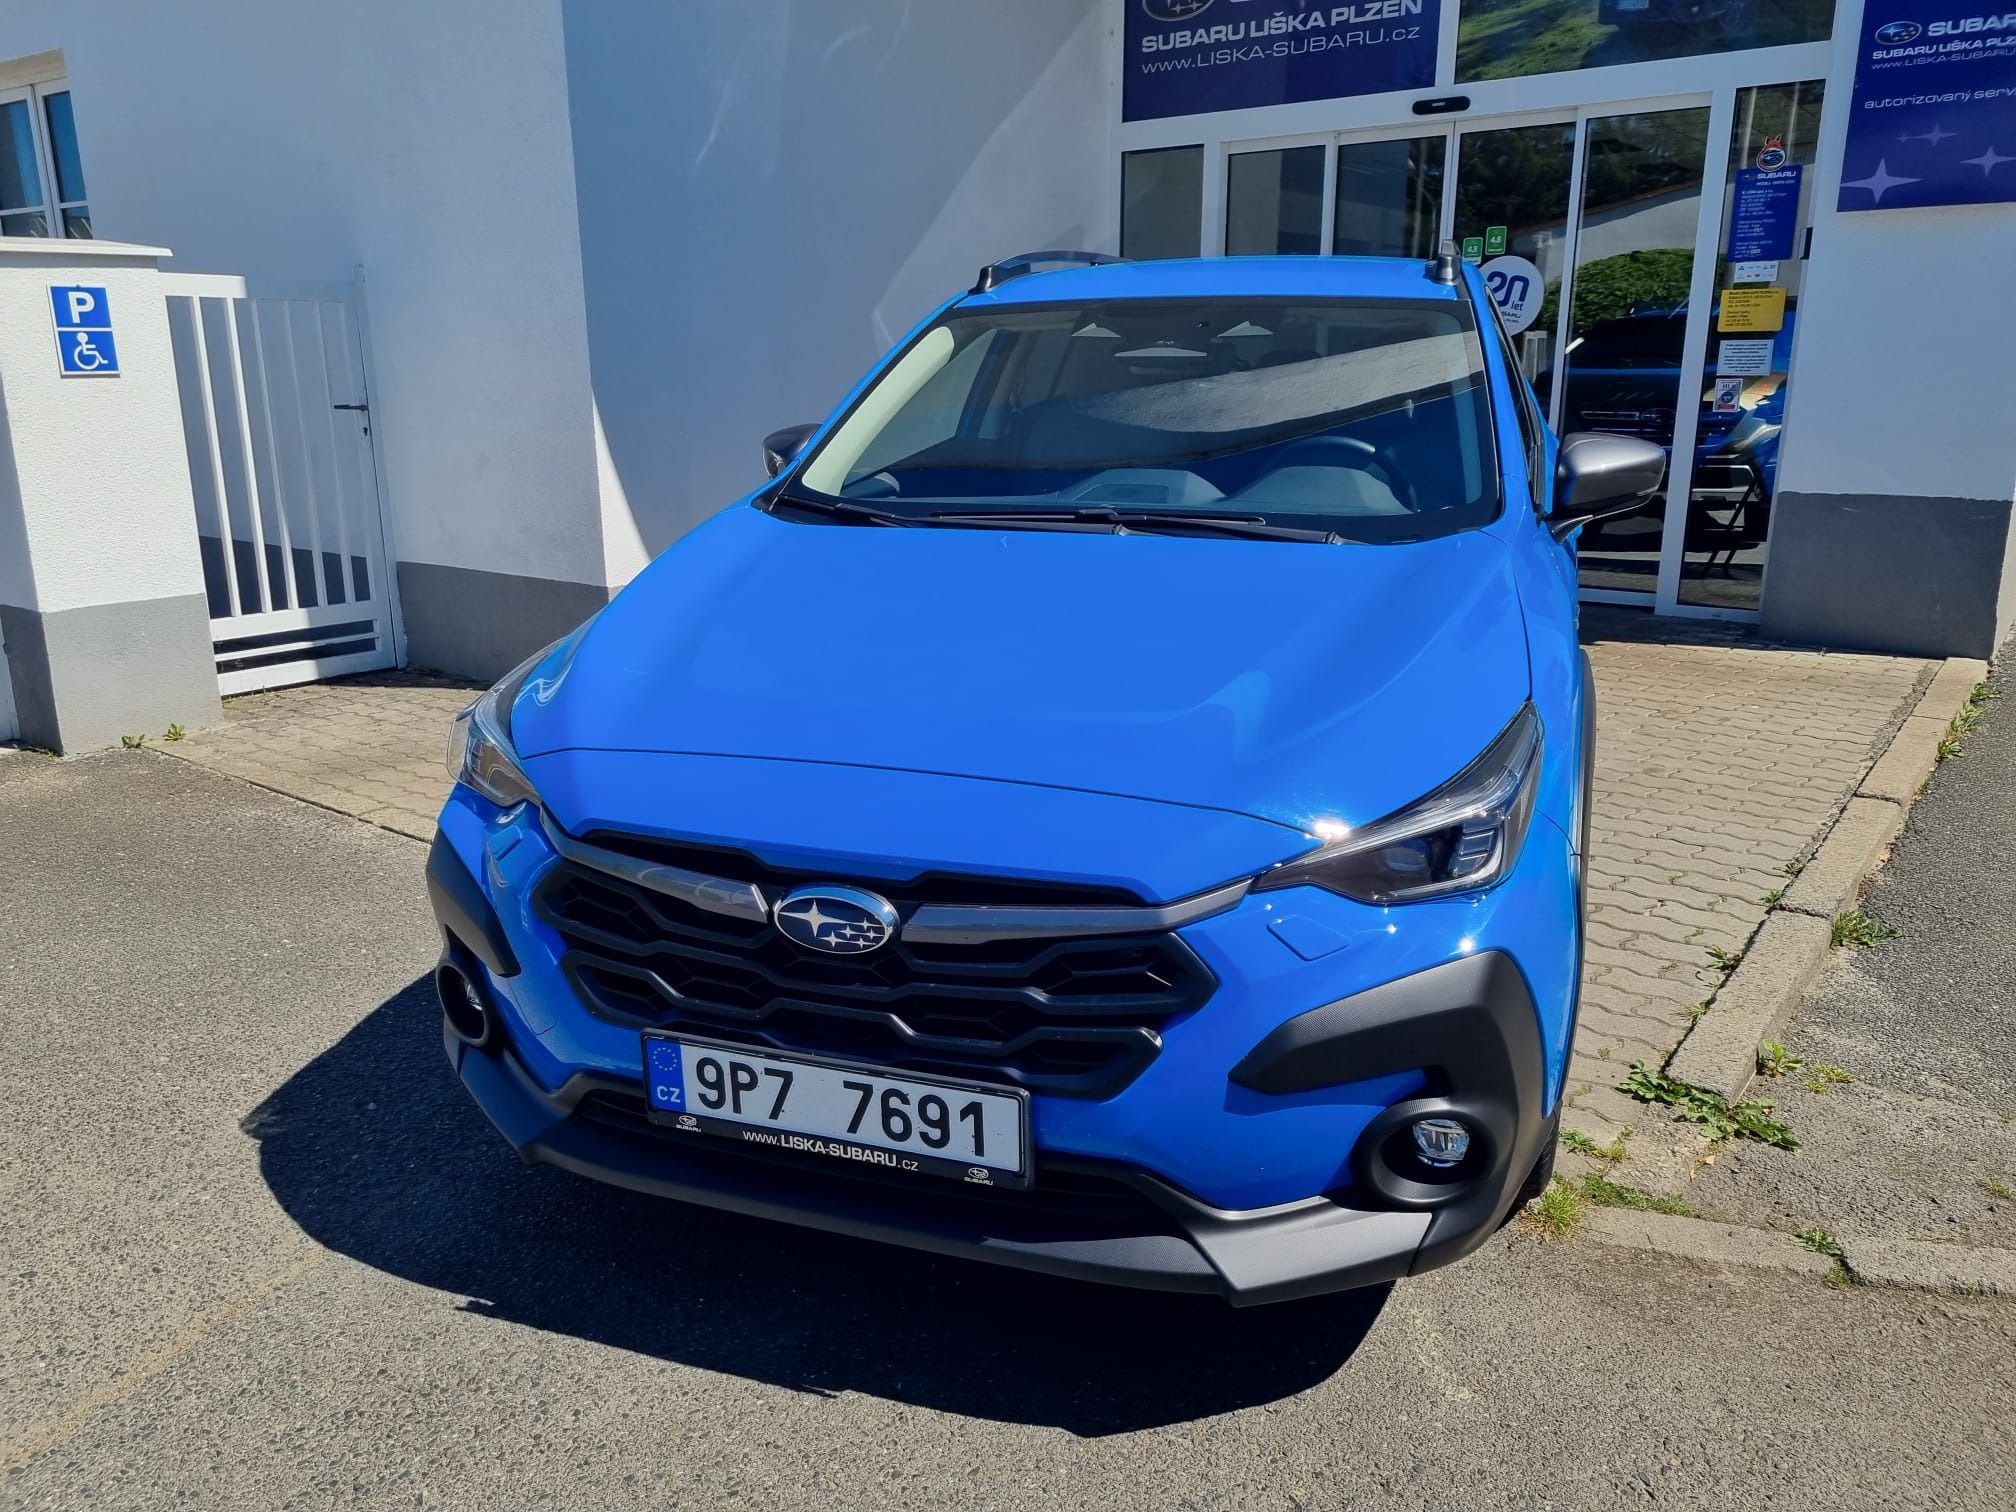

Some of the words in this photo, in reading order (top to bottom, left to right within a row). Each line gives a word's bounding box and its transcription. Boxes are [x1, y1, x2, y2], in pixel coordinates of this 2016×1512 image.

[1142, 22, 1246, 53] SUBARU
[1250, 11, 1326, 37] LIŠKA
[1142, 27, 1421, 74] www.LISKA-SUBARU.cz
[1872, 44, 1937, 60] SUBARU
[1939, 39, 1984, 53] LIŠKA
[1864, 90, 1972, 109] autorizovaný
[1757, 171, 1797, 179] SUBARU
[68, 291, 95, 324] P
[656, 1085, 682, 1104] CZ
[695, 1057, 794, 1121] 9P7
[842, 1080, 986, 1157] 7691
[675, 1124, 702, 1133] SUBARU
[742, 1129, 919, 1172] www.LISKA-SUBARU.cz
[964, 1176, 994, 1186] SUBARU
